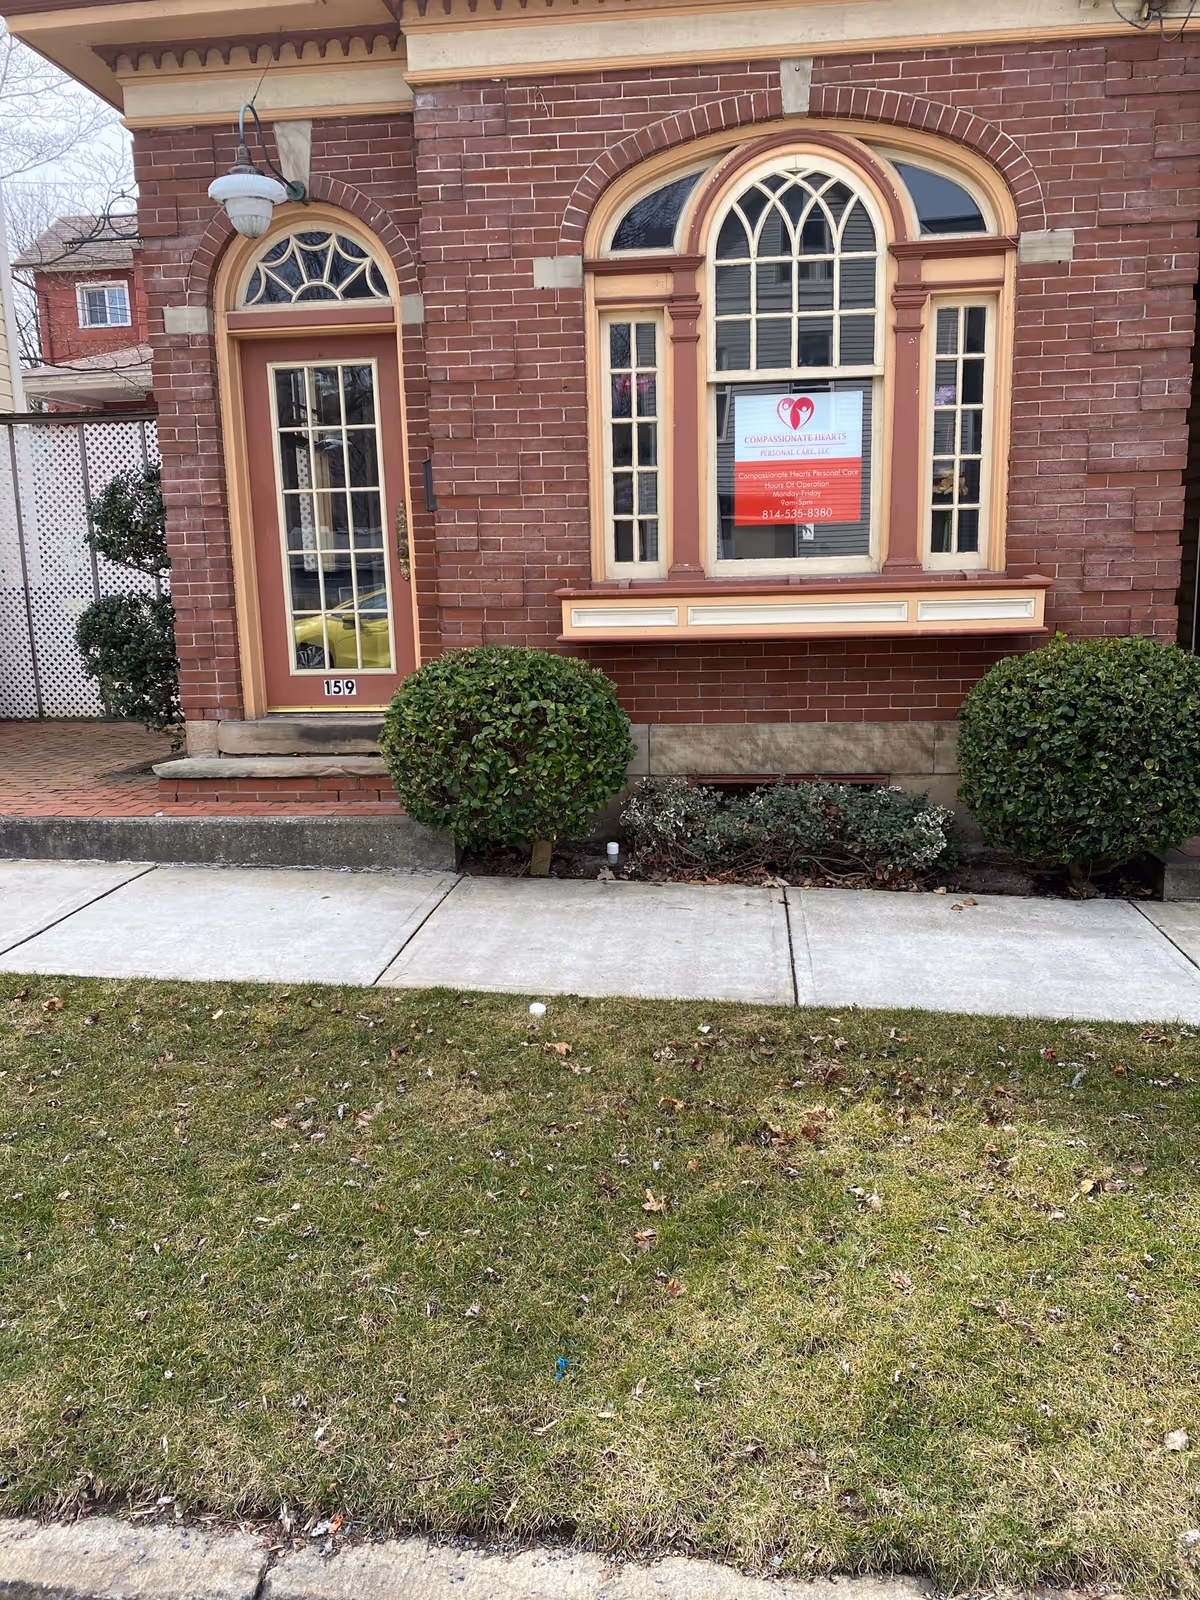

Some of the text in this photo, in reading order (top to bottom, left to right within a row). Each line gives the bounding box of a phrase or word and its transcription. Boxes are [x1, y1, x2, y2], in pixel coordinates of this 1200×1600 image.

[744, 432, 847, 444] COMPASSIONATE HEARTS
[760, 448, 794, 457] PERSONAL
[818, 447, 830, 455] LLC
[738, 468, 859, 480] Compassionate Hearts Personal Care
[764, 480, 830, 489] Hours Of Operation
[772, 490, 822, 498] Monday-Friday
[780, 498, 814, 506] 9am-5pm
[762, 508, 833, 519] 814-535-8380
[325, 680, 355, 695] 159
